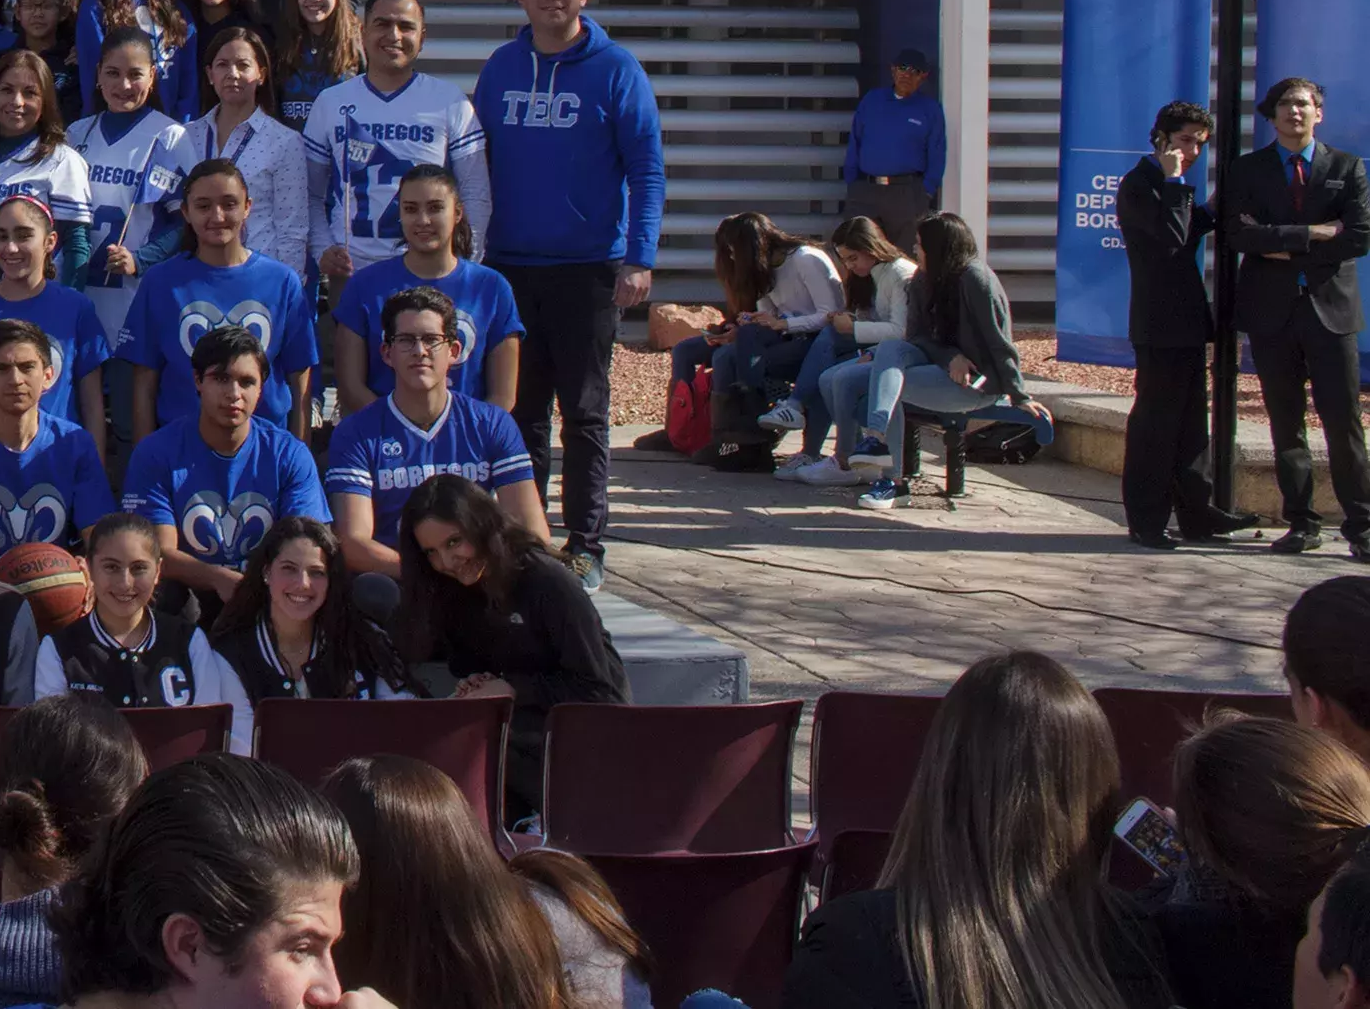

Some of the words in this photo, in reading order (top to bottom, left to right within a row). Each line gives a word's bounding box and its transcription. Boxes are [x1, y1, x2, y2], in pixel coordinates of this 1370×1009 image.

[502, 90, 581, 128] TEC
[333, 122, 436, 146] BRREGOS
[160, 666, 191, 707] C
